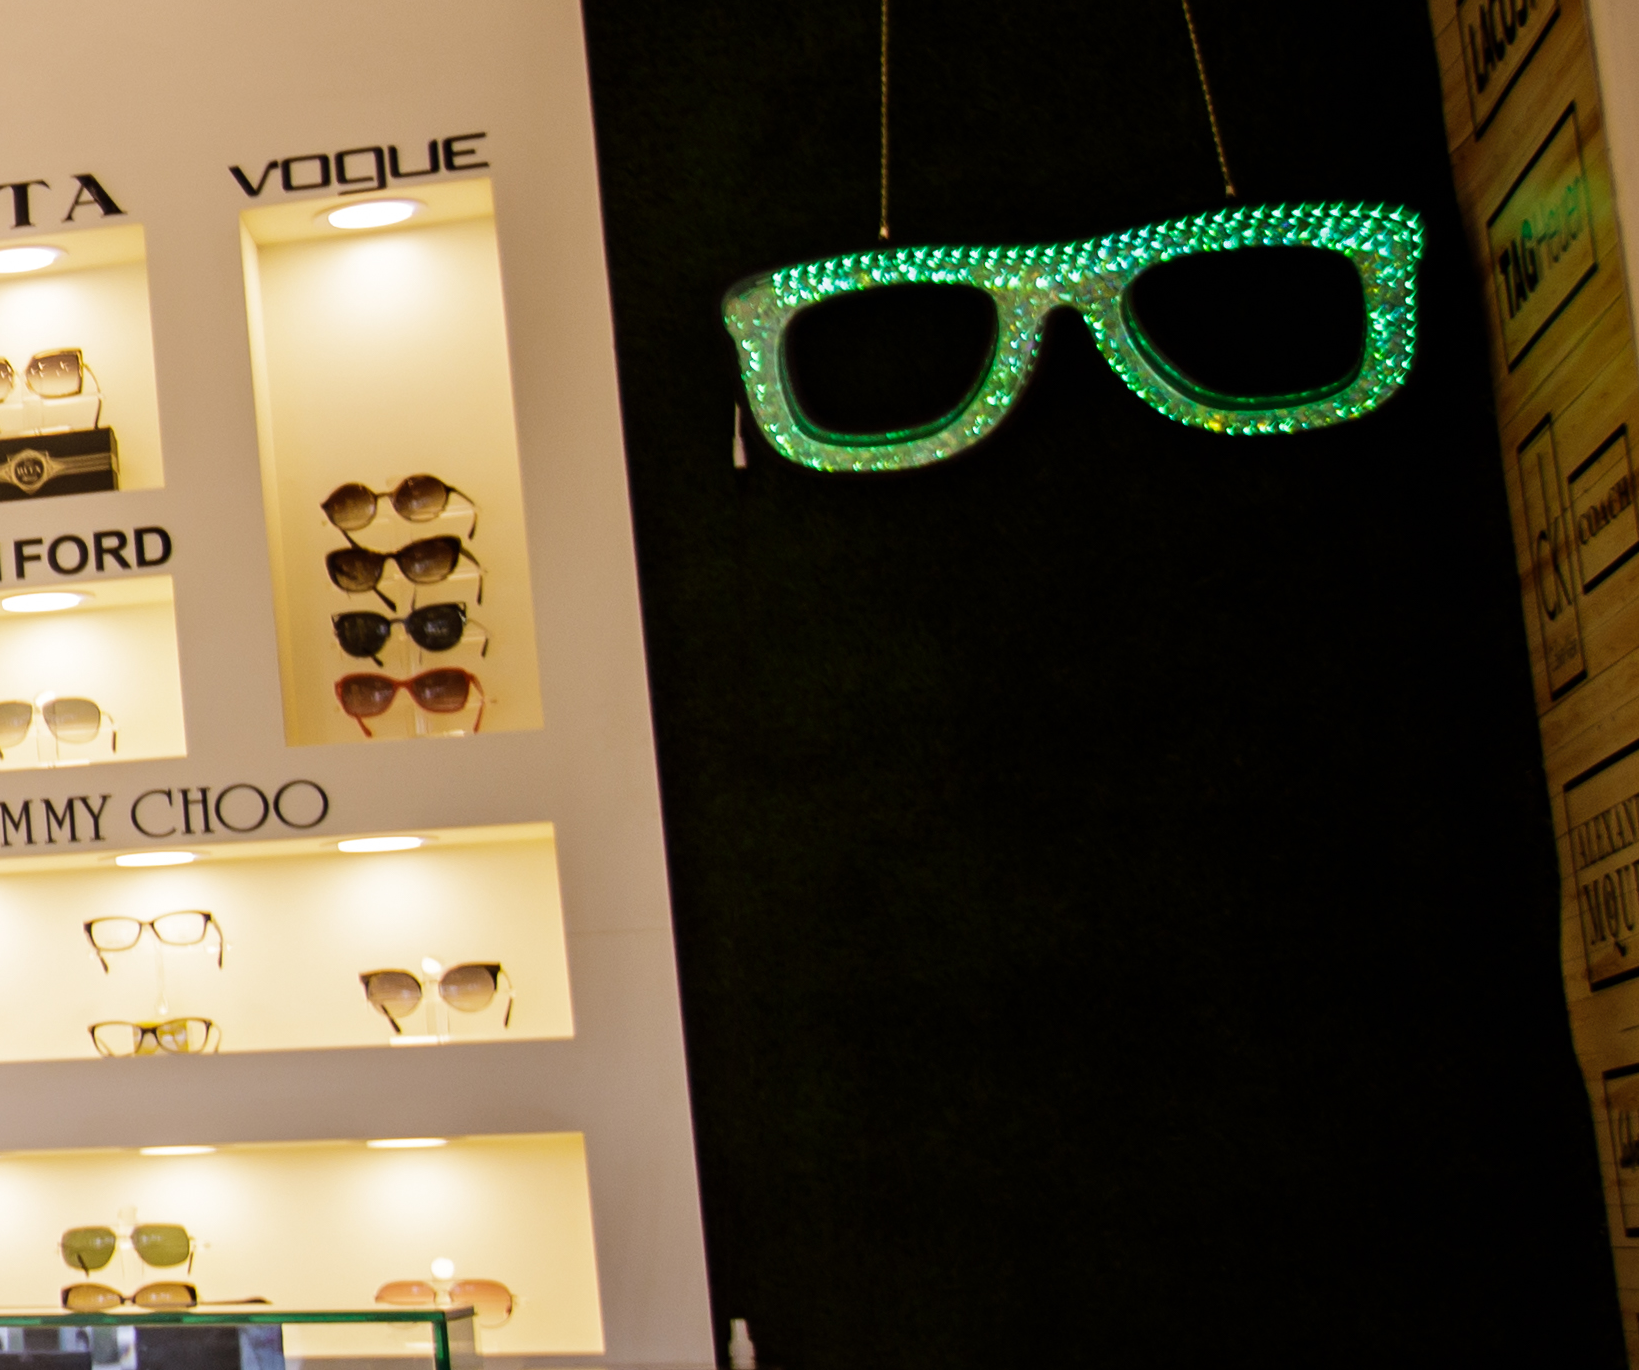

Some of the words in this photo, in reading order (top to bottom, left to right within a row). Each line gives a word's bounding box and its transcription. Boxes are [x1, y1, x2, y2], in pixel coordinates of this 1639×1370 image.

[229, 132, 490, 197] VOGUE
[13, 526, 173, 579] FORD
[130, 780, 330, 836] CHOO
